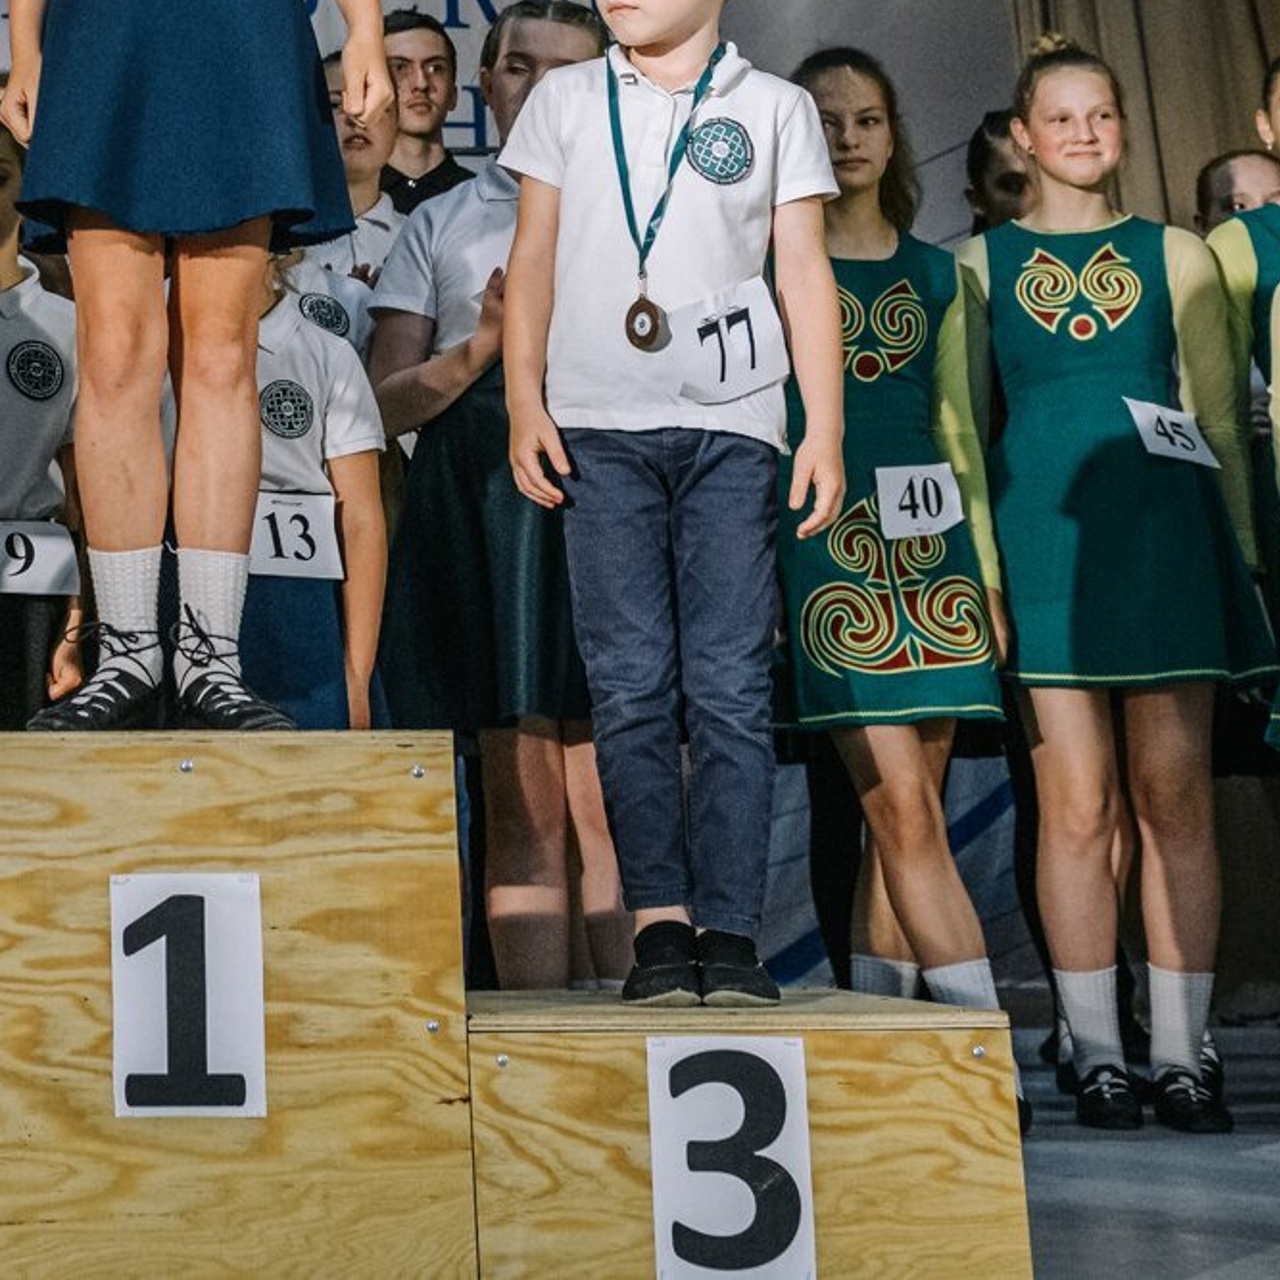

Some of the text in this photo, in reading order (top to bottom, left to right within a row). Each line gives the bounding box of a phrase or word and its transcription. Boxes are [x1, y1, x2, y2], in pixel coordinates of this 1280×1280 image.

[696, 307, 756, 383] 77
[1153, 415, 1197, 452] 45
[898, 476, 943, 520] 40
[4, 531, 35, 577] 9
[262, 511, 317, 562] 13
[122, 894, 247, 1108] 1
[668, 1049, 802, 1272] 3
